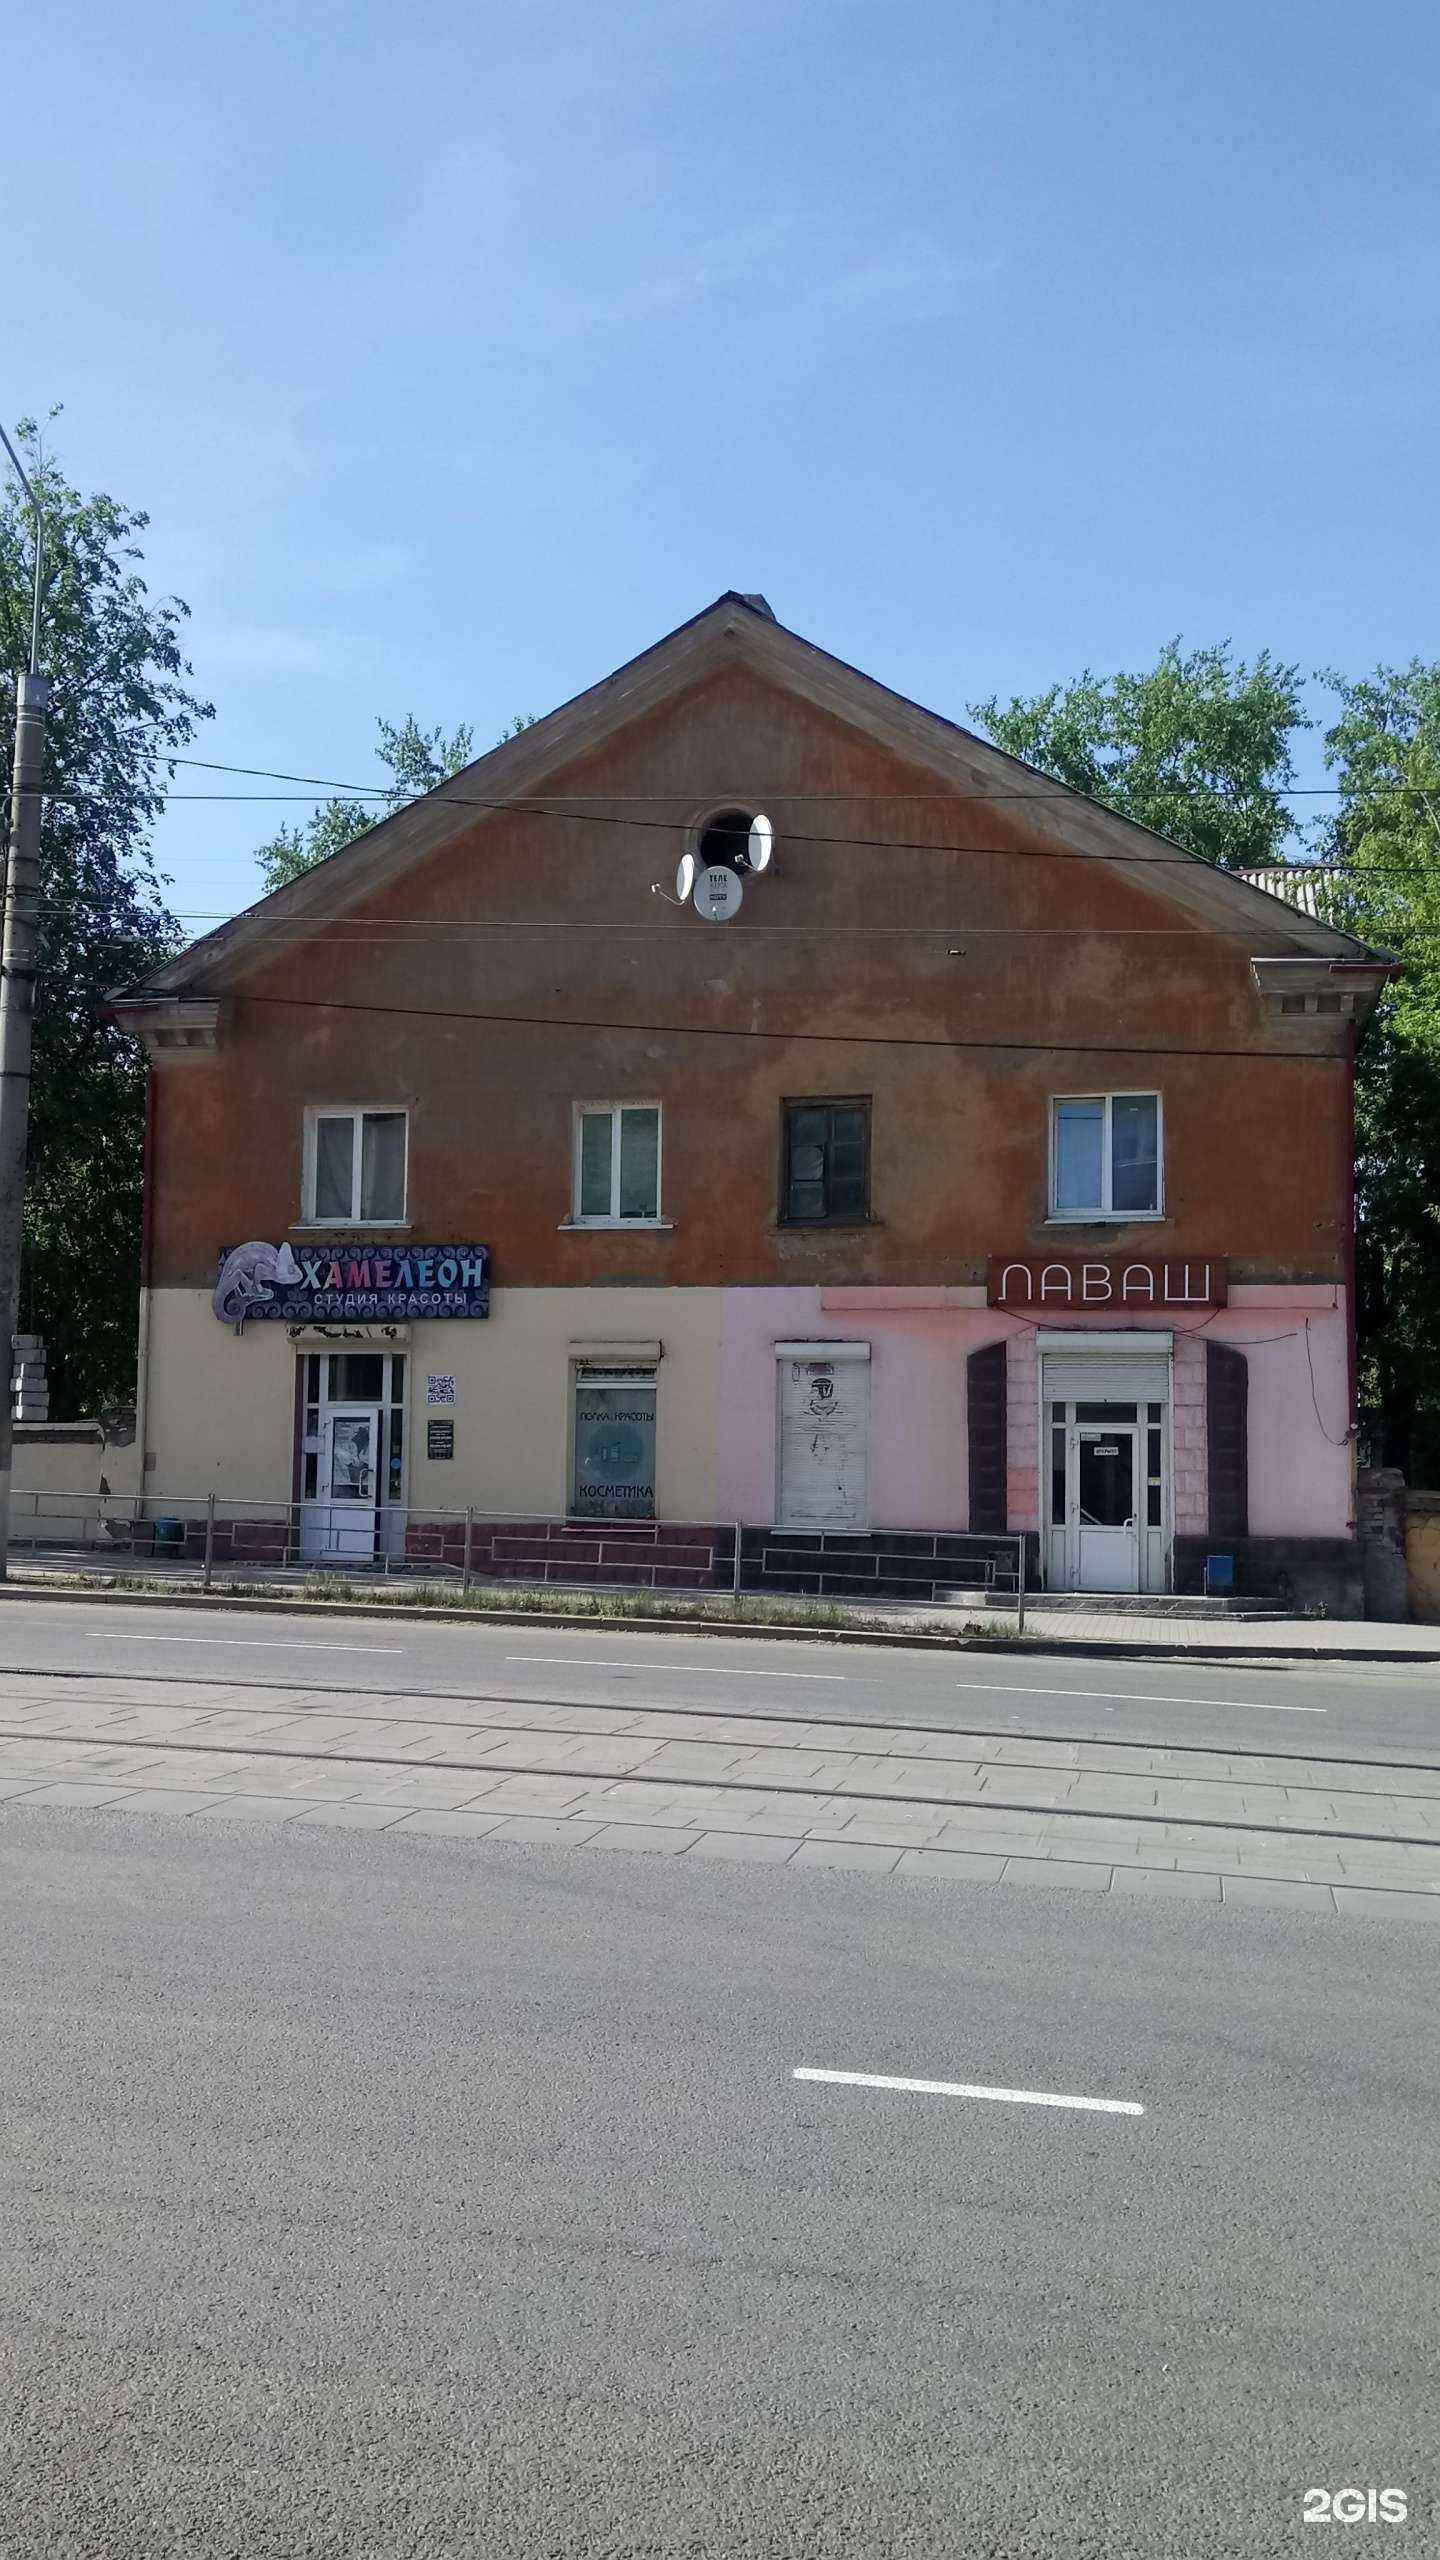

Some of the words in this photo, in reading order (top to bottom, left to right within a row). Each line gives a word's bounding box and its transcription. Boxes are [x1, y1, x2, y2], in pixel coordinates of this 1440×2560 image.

[300, 1258, 483, 1290] ХАМЕЛЕОН
[998, 1264, 1210, 1301] ЛАВАШ
[314, 1293, 378, 1306] СТУДИЯ
[388, 1292, 467, 1305] КРАСОТЫ
[579, 1485, 654, 1499] КОСМЕТИКА
